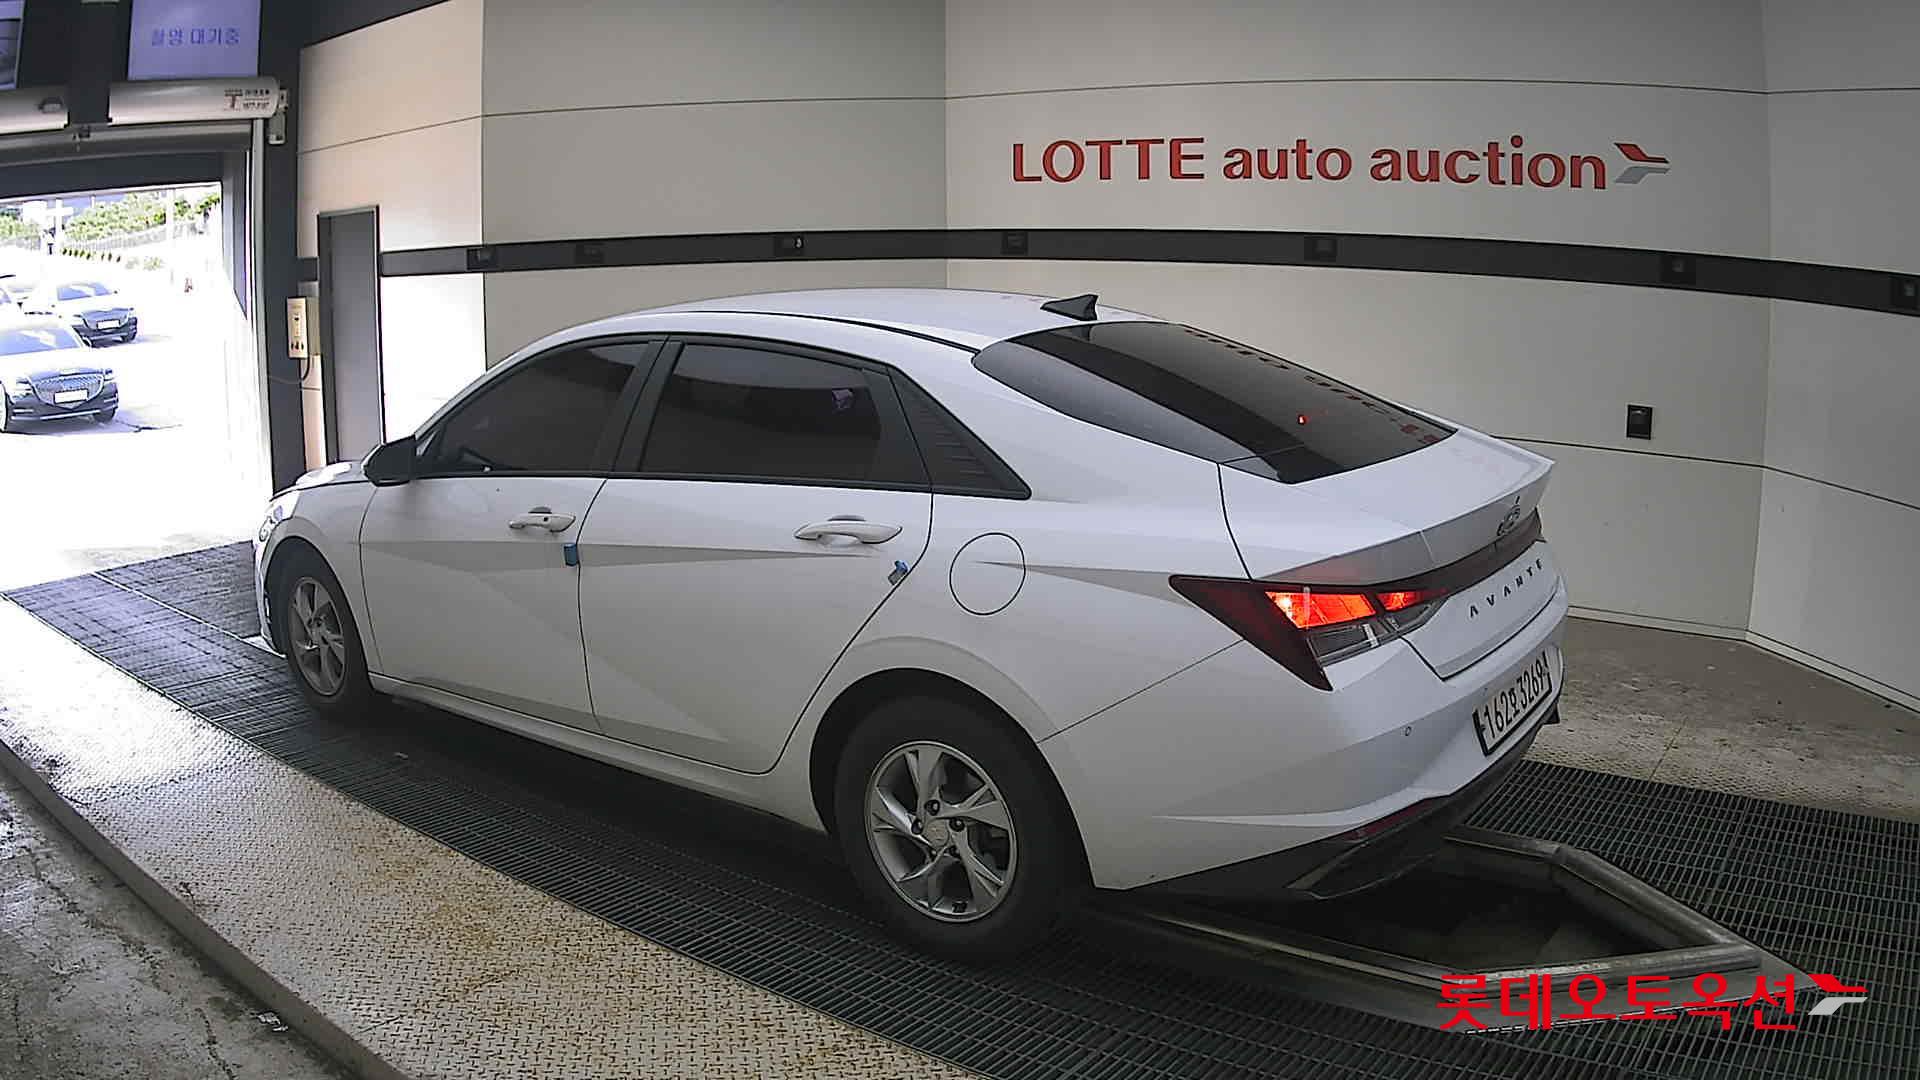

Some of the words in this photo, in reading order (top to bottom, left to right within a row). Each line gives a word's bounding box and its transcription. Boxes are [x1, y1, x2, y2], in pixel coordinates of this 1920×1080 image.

[1013, 138, 1206, 183] LOTTE
[1224, 138, 1353, 181] auto
[1370, 135, 1607, 190] auction
[1469, 558, 1543, 618] AVANTE
